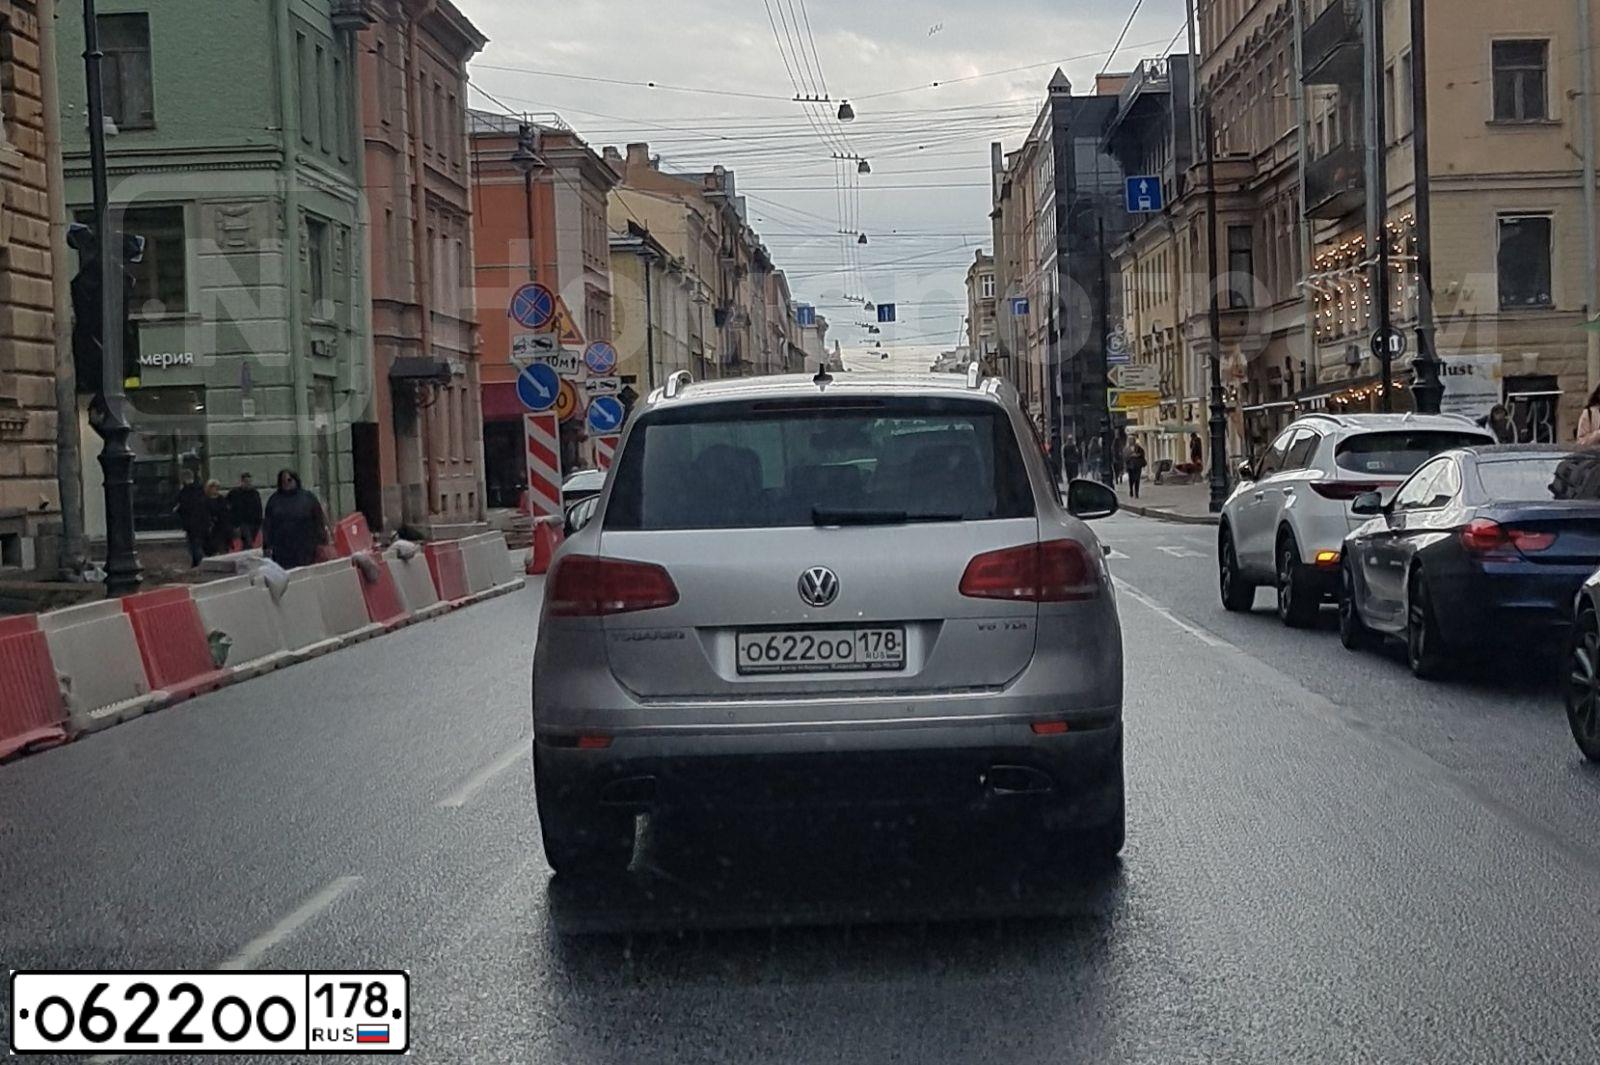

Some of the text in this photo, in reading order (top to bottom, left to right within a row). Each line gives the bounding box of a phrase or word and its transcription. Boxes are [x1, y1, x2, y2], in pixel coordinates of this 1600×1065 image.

[1439, 361, 1473, 376] lust
[858, 632, 896, 652] 178
[865, 651, 885, 660] RUS
